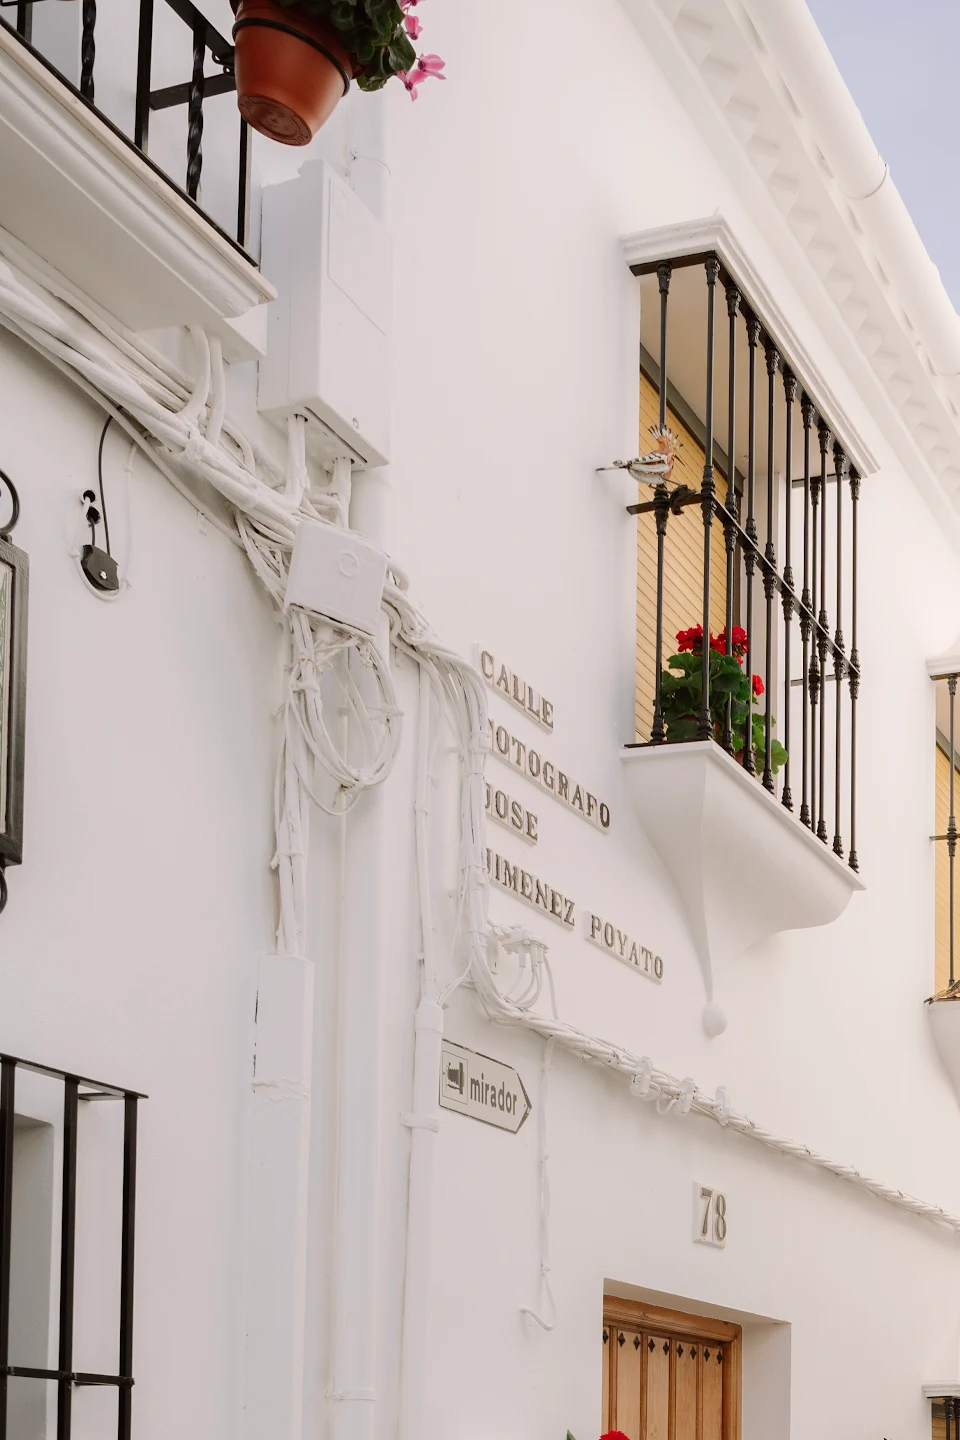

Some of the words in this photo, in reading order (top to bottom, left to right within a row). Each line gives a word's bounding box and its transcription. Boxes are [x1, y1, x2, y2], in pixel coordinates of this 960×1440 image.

[481, 650, 554, 729] CALLE
[487, 717, 611, 829] OTOGRAFO
[484, 782, 539, 841] JOSE
[485, 847, 576, 927] JIMENEZ
[590, 914, 664, 979] POYATO
[470, 1072, 517, 1116] mirador
[701, 1187, 727, 1242] 78
